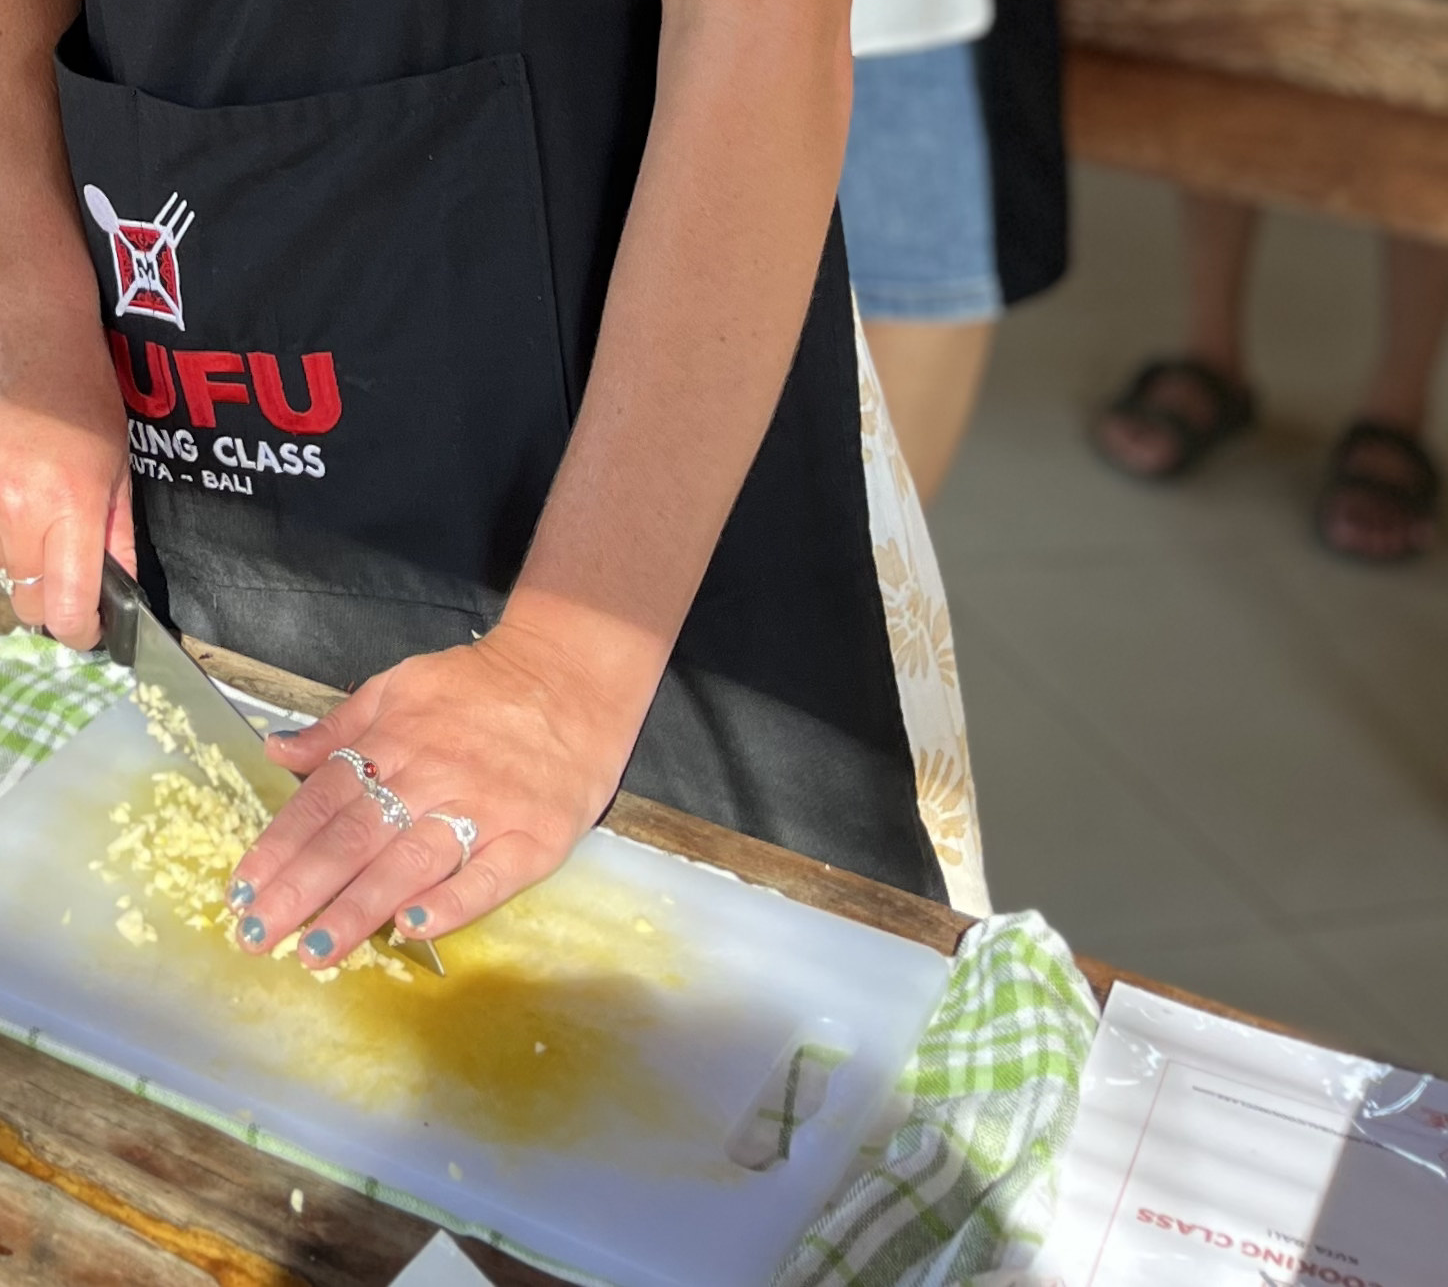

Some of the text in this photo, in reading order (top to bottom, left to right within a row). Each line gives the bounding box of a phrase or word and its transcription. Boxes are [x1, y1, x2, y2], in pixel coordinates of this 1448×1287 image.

[110, 329, 342, 435] UFU
[127, 418, 326, 479] KING CLASS
[201, 470, 253, 495] BALI
[1136, 1207, 1234, 1249] CLASS
